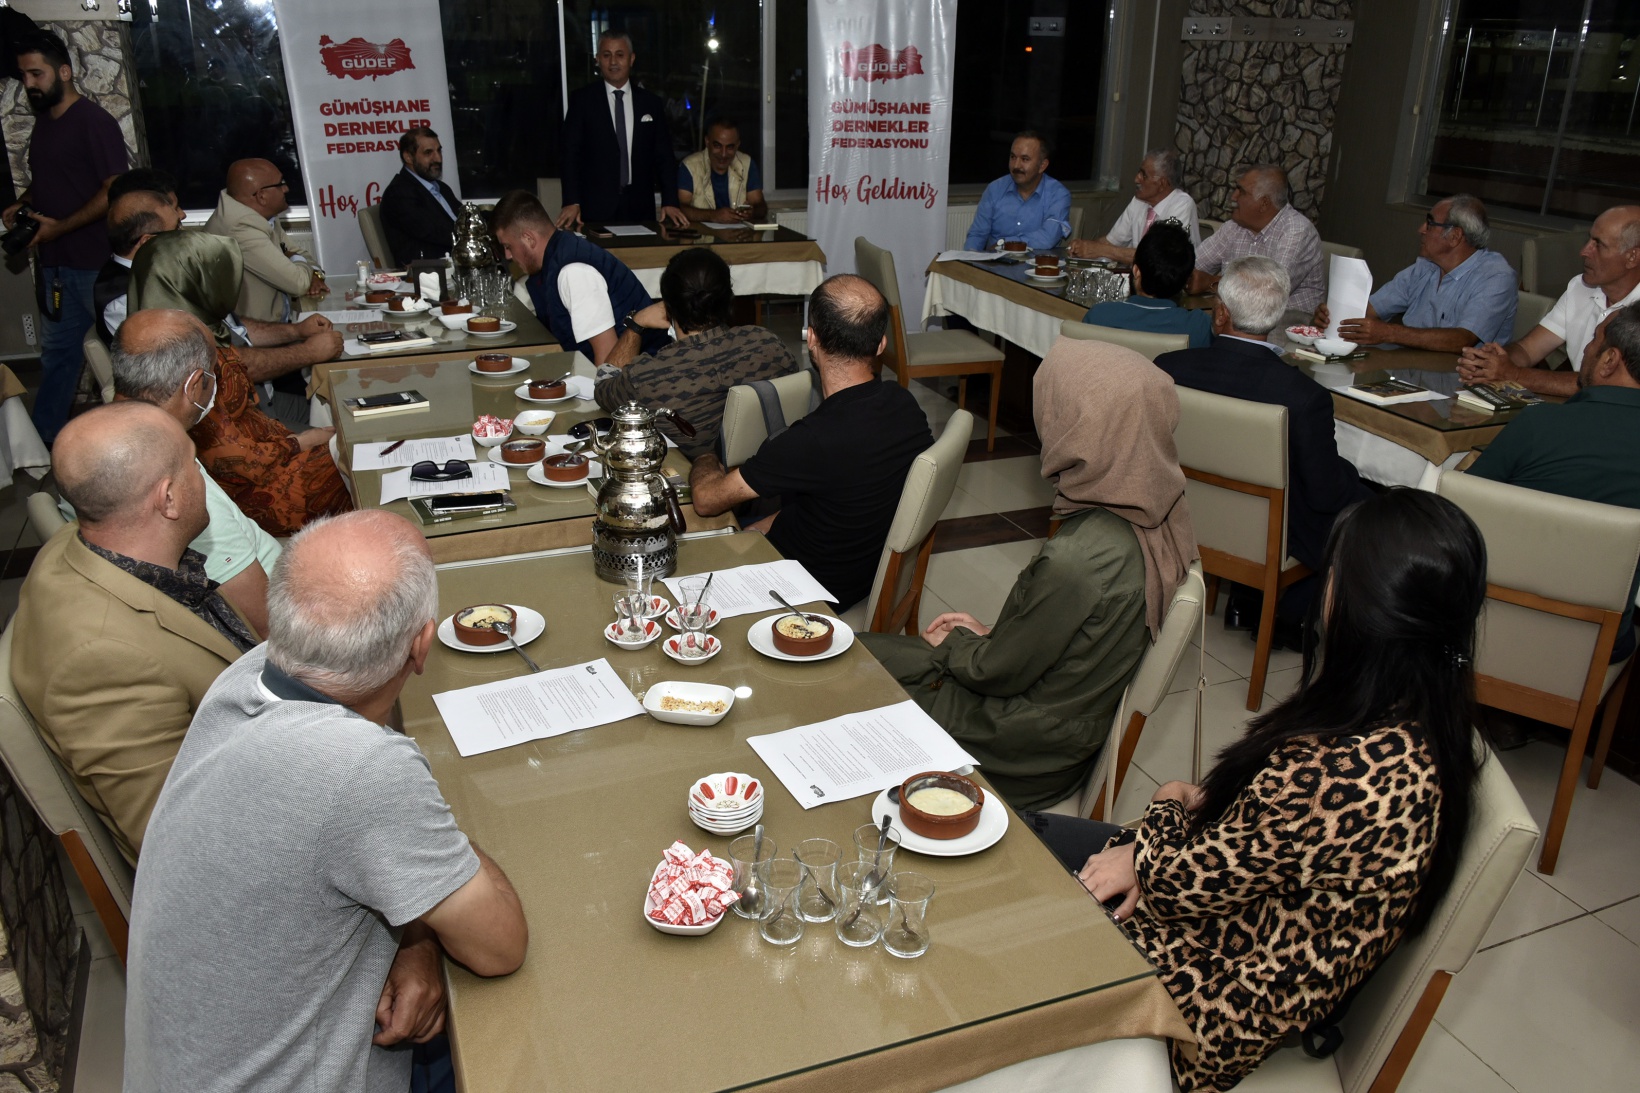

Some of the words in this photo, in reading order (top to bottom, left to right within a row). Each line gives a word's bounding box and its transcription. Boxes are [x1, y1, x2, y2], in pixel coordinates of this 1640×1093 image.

[341, 55, 396, 69] GÜDEF
[857, 59, 907, 73] GÜDEF
[319, 98, 431, 116] GÜMÜŞHANE
[831, 99, 931, 116] GÜMÜŞHANE
[832, 120, 929, 133] DERNEKLER
[831, 138, 929, 149] FEDERASYONU
[815, 174, 851, 205] Hoş
[857, 174, 938, 209] Geldiniz
[319, 184, 358, 219] Hoş
